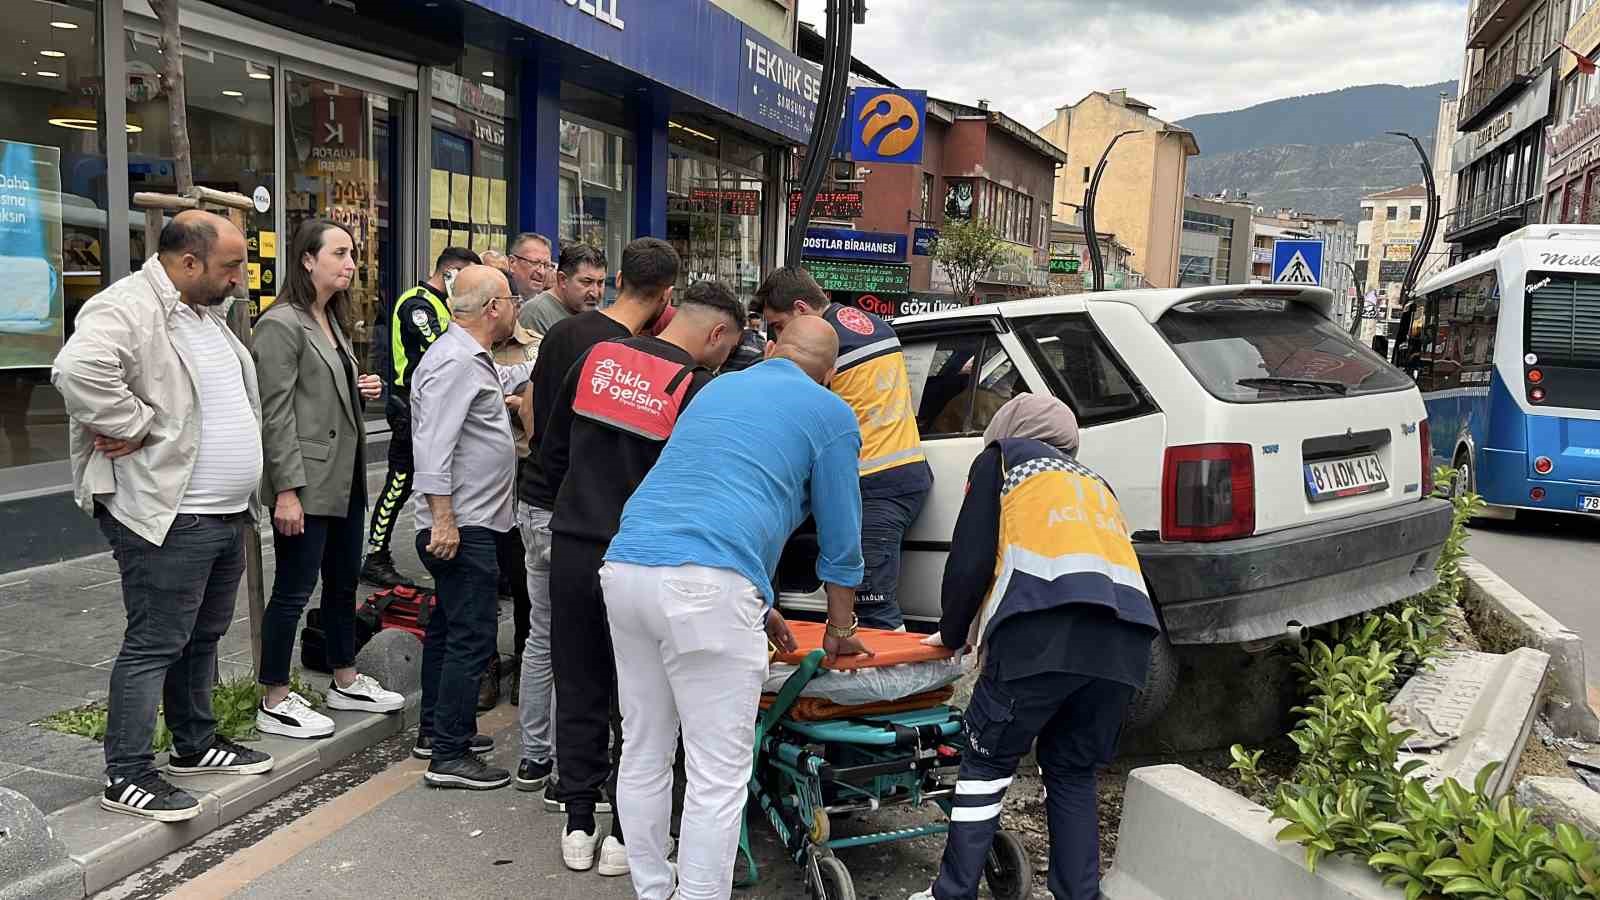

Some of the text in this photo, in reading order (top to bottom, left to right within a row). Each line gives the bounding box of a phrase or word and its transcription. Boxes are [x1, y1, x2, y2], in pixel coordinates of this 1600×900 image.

[803, 237, 897, 254] DOSTLAR BİRAHANESİ
[609, 385, 663, 411] gelsin
[1313, 456, 1383, 491] 81 ADM 143
[1585, 497, 1599, 509] 78
